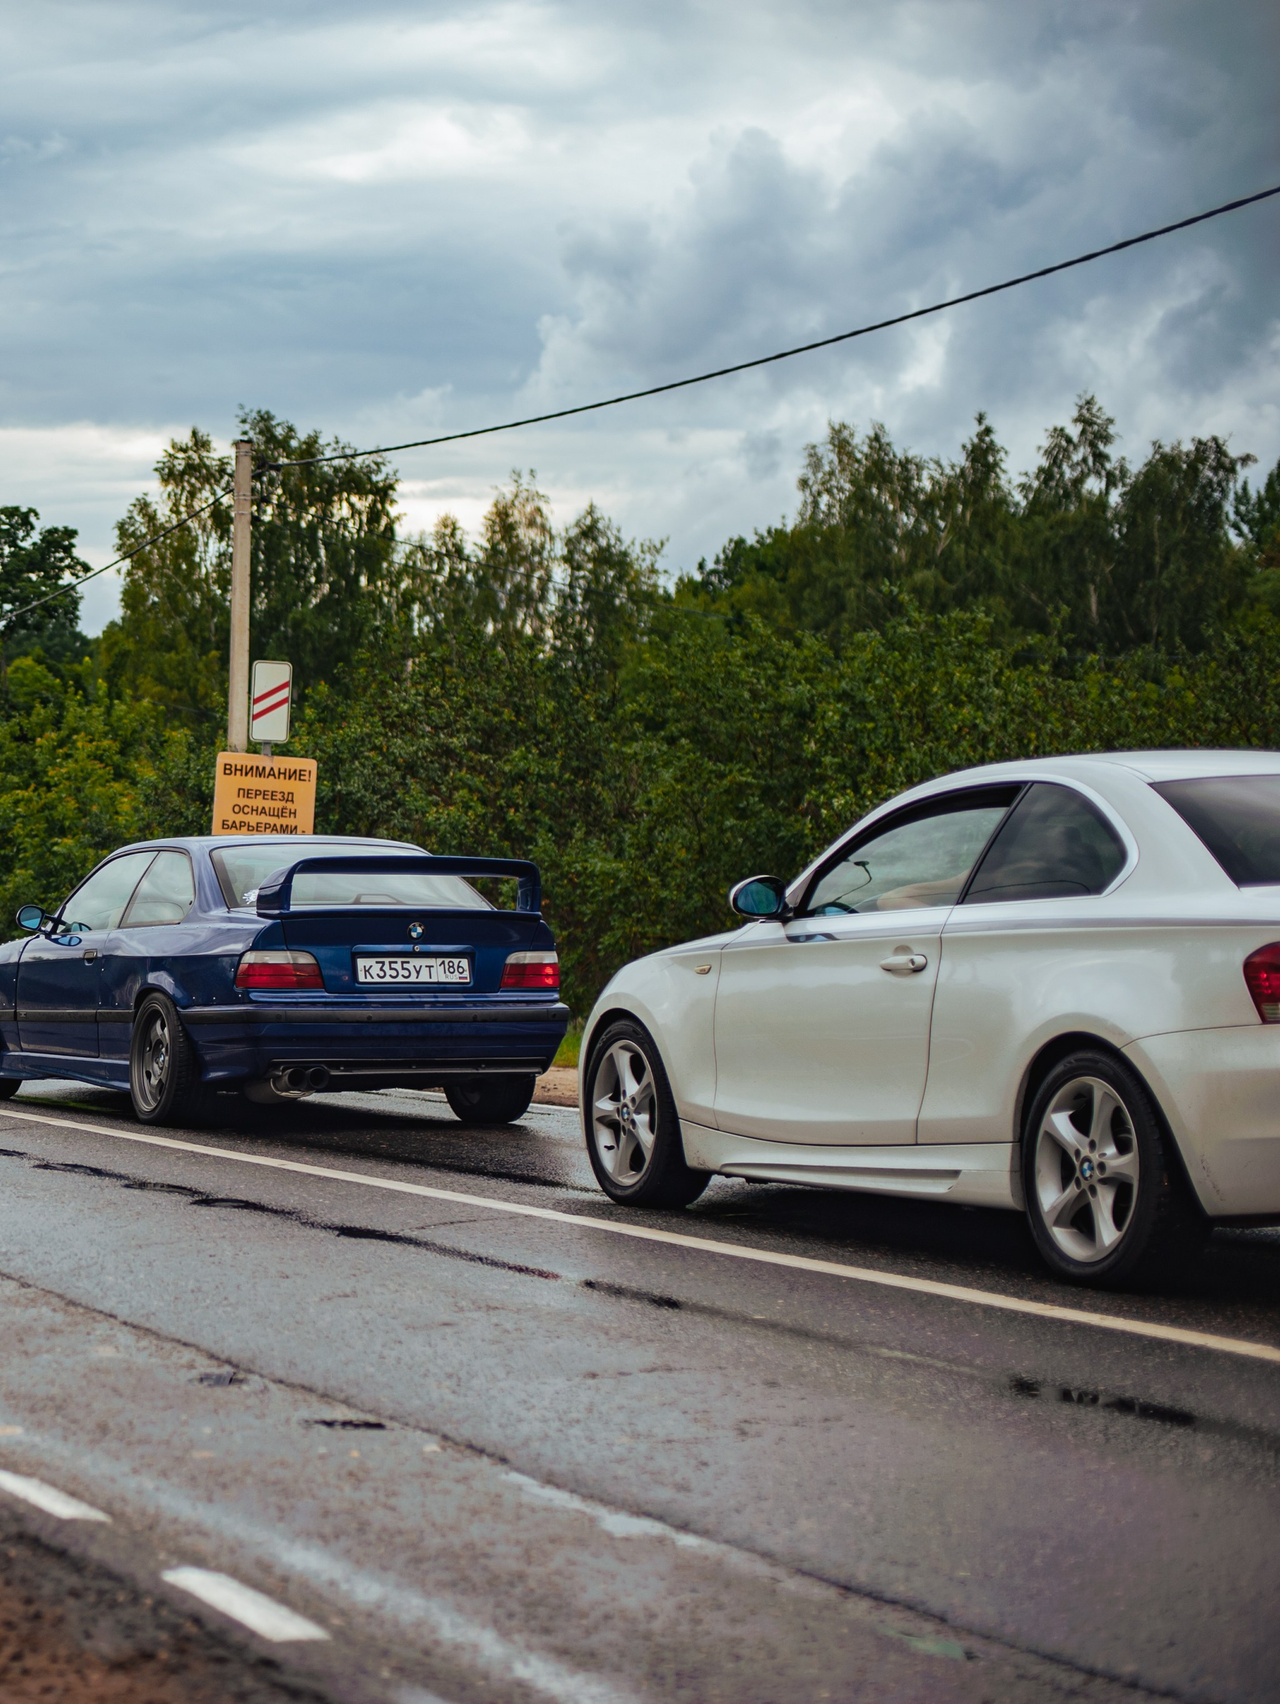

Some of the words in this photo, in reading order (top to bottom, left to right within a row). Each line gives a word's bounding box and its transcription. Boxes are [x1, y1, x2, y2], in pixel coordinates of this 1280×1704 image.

[223, 763, 312, 782] ВНИМАНИЕ!
[237, 788, 295, 804] ПЕРЕЕЗД
[232, 804, 297, 819] ОСНАЩЁН
[221, 819, 298, 834] БАРЬЕРАМИ
